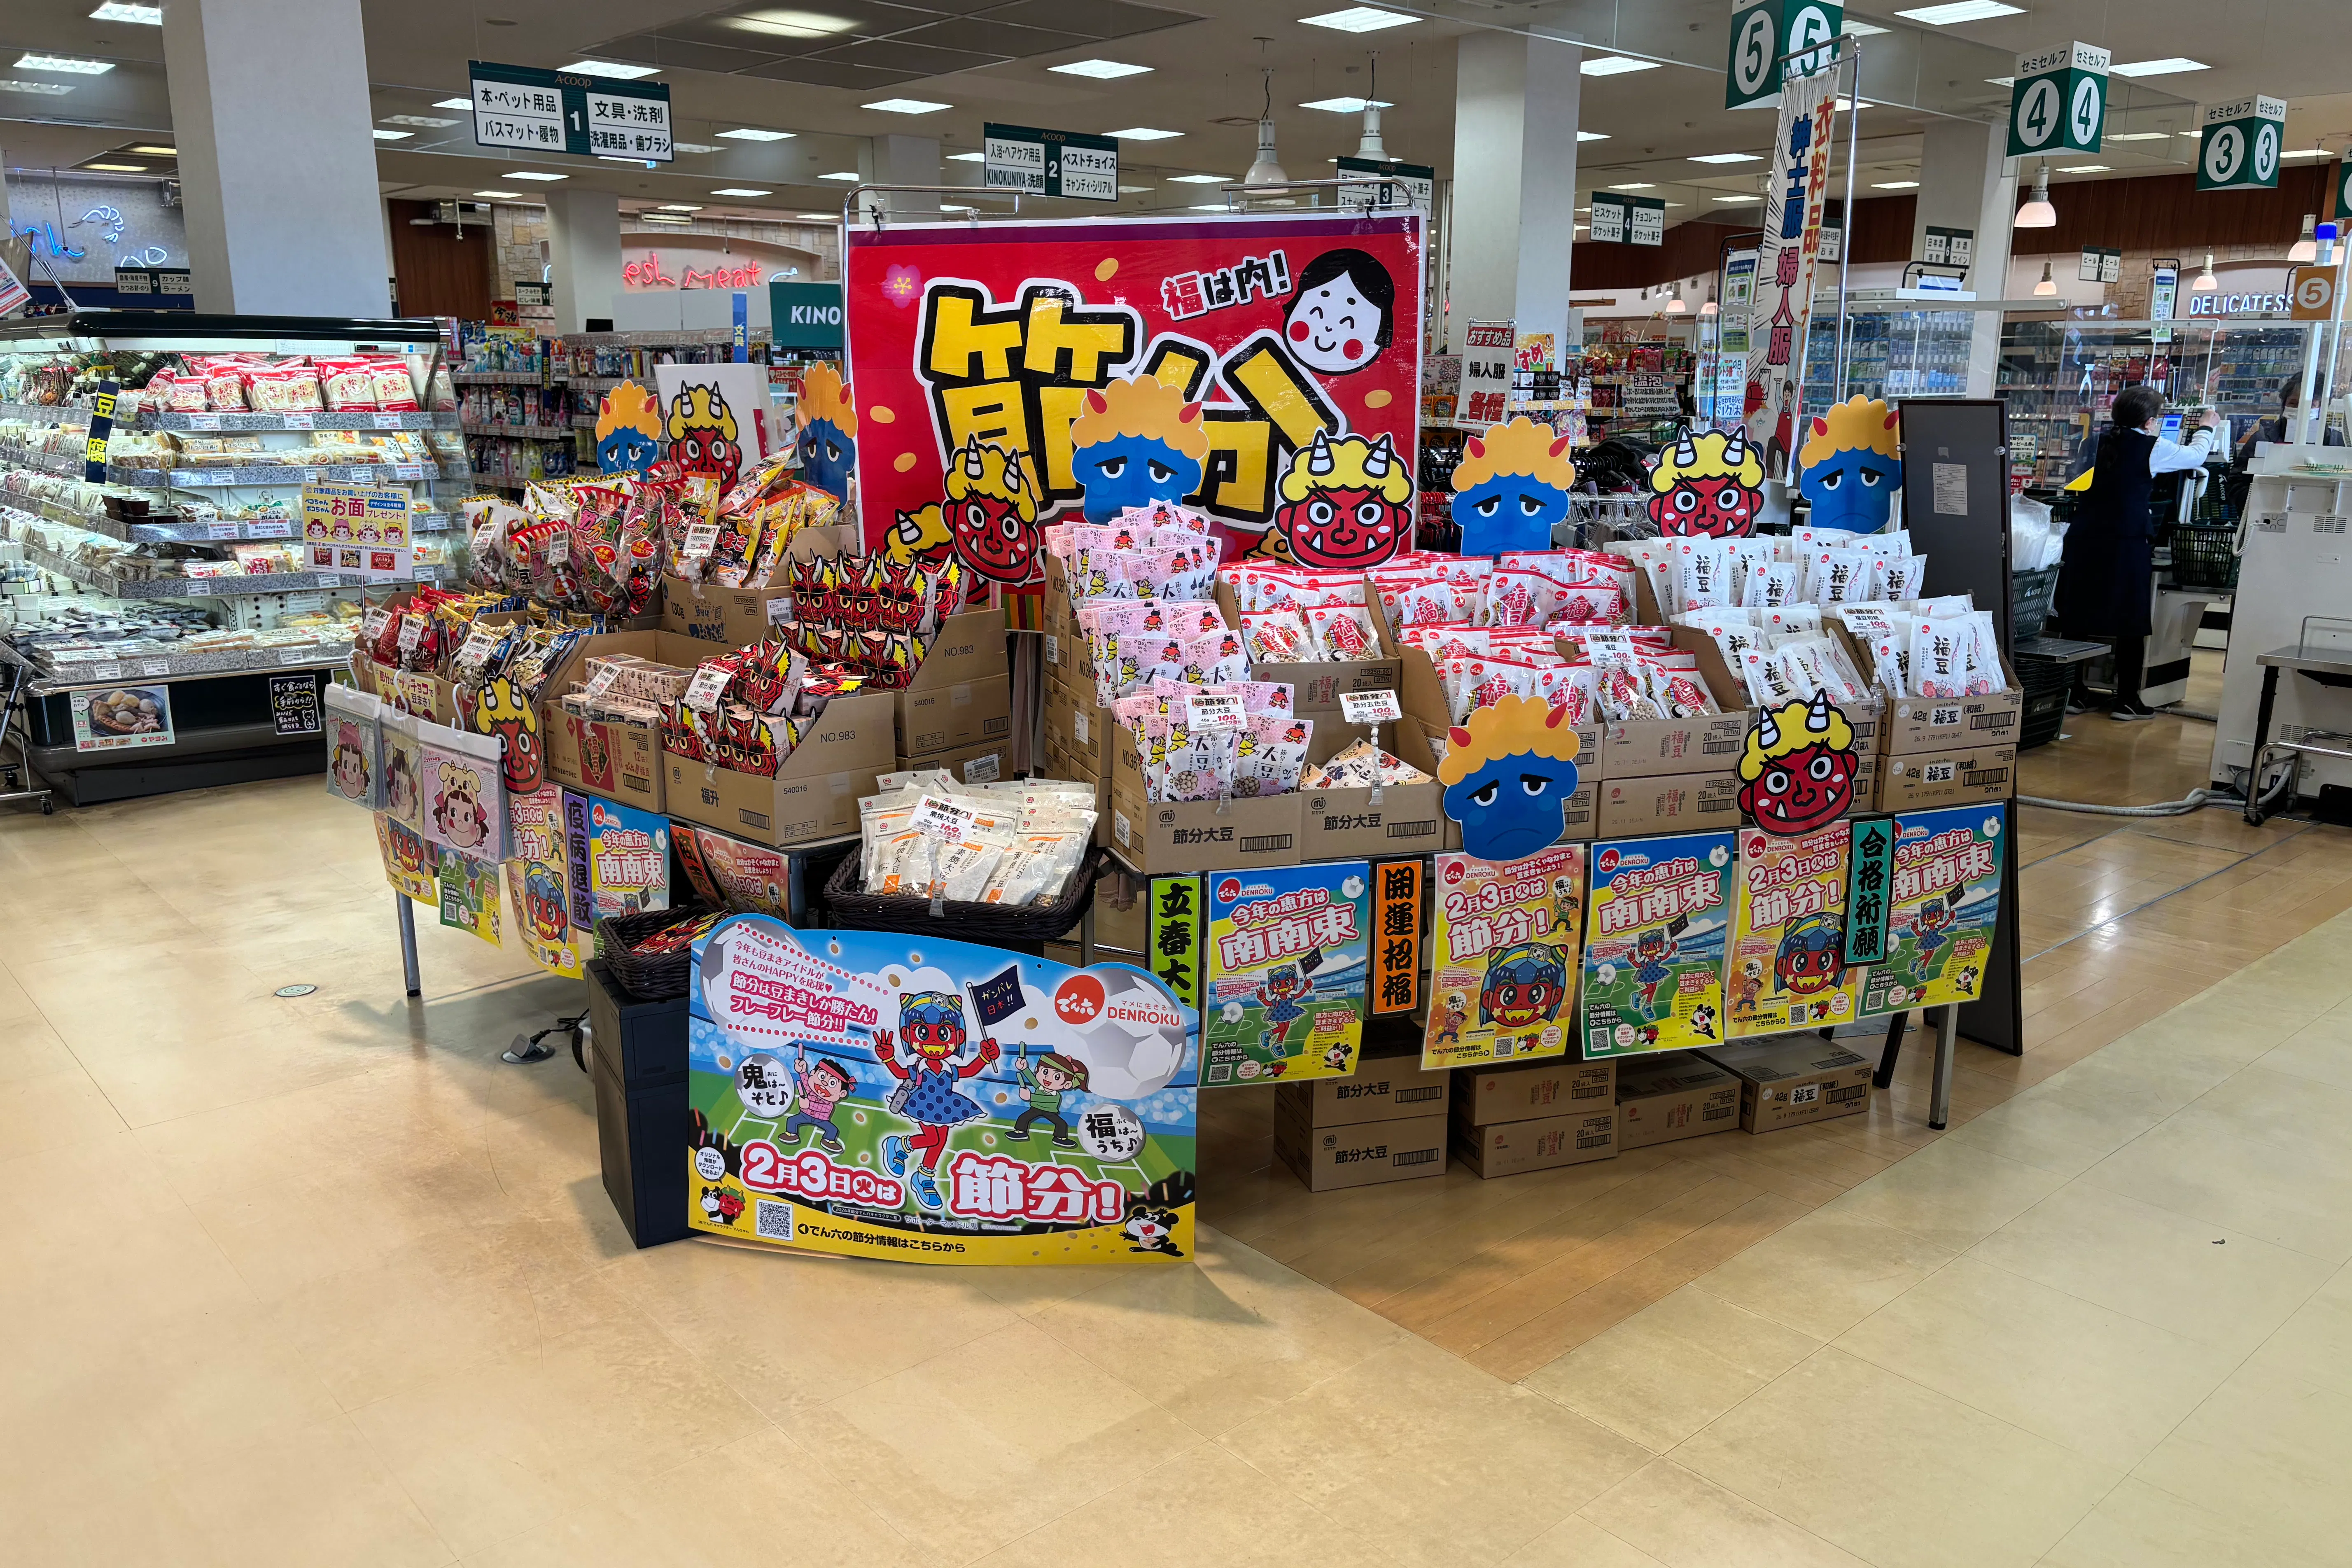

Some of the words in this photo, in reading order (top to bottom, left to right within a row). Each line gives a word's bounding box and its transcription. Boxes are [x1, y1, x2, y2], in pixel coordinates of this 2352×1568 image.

[1745, 20, 1764, 82] 5
[1801, 18, 1820, 77] 5
[2021, 51, 2066, 72] セミセルフ
[2077, 49, 2106, 68] セミセルフ
[481, 88, 556, 113] 本・ペット用品
[2209, 102, 2251, 120] セミセルフ
[2259, 101, 2283, 116] セミセルフ
[570, 111, 580, 131] 1
[595, 100, 663, 124] 文具・洗剤
[2027, 88, 2046, 137] 4
[2071, 87, 2091, 136] 4
[485, 119, 559, 144] バスマット・履物
[590, 130, 670, 154] 洗濯用品・歯ブラシ
[991, 143, 1041, 162] 入浴・ヘアケア用品
[1063, 154, 1115, 170] ベストチョイス
[2215, 133, 2232, 174] 3
[2260, 133, 2270, 173] 3
[1049, 161, 1058, 177] 2
[1066, 177, 1112, 194] キャンディ・シリアル
[1383, 188, 1389, 202] 3
[1595, 207, 1621, 219] ビスケット
[1635, 211, 1661, 223] チョコレート
[1593, 226, 1620, 238] ポケット菓子
[1625, 218, 1630, 230] 4
[1634, 229, 1660, 242] ポケット菓子
[1953, 256, 1967, 264] ワイン
[2084, 256, 2096, 264] ビール
[684, 261, 762, 289] meat
[1162, 249, 1293, 319] 福は内!
[2305, 283, 2322, 304] 5
[791, 306, 841, 325] KINO
[1467, 330, 1513, 347] おすすめ品
[1469, 361, 1505, 380] 婦人服
[1468, 391, 1506, 421] 各種
[86, 392, 117, 464] 豆腐
[313, 488, 404, 499] 対象商品をお買い上げのお客様に
[331, 497, 365, 518] お面
[366, 509, 406, 520] プレゼント!
[1695, 554, 1712, 593] 福豆
[1828, 563, 1849, 602] 福豆
[671, 601, 685, 619] 130g
[1332, 616, 1362, 656] 福豆
[945, 645, 974, 658] NO.983
[1932, 635, 1951, 676] 福豆
[1764, 661, 1791, 697] 福豆
[411, 693, 431, 707] 豆まき!
[1318, 676, 1332, 704] 福豆
[914, 698, 935, 707] 540016
[1912, 710, 1927, 722] 42g
[1932, 708, 1959, 725] 福豆
[1963, 703, 1985, 715] (和紙)
[821, 730, 856, 743] NO.983
[1671, 730, 1684, 758] 福豆
[1260, 746, 1277, 778] 大豆
[1906, 767, 1920, 779] 42g
[1926, 766, 1952, 782] 福豆
[1955, 760, 1977, 771] (和紙)
[701, 787, 719, 807] 福升
[784, 785, 807, 795] 540016
[1323, 813, 1382, 831] 節分大豆
[601, 830, 650, 849] 今年の恵方は
[1172, 826, 1234, 845] 節分大豆
[1902, 830, 1928, 838] DENROKU
[1767, 844, 1794, 852] DENROKU
[1896, 830, 1971, 864] 今年の恵方は
[568, 800, 591, 925] 疫病退散
[597, 852, 666, 888] 南南東
[1504, 852, 1573, 875] 節分はかぞくやなかまと
[1516, 862, 1563, 880] 豆まきをしよう!
[1892, 845, 1994, 901] 南南東
[1465, 870, 1496, 879] DENROKU
[1612, 859, 1696, 892] 今年の恵方は
[1241, 887, 1273, 896] DENROKU
[1600, 872, 1720, 932] 南南東
[1852, 826, 1887, 957] 合格祈願
[1234, 890, 1327, 926] 今年の恵方は
[1752, 879, 1841, 929] 節分!
[1221, 905, 1357, 967] 南南東
[1381, 865, 1416, 1008] 開運招福
[1450, 907, 1549, 958] 節分!
[734, 940, 825, 980] 今年も豆まきアイドルが
[733, 972, 877, 1024] 節分は豆まきしか勝たん!
[981, 982, 1013, 1000] ガンバレ
[730, 996, 845, 1030] フレーフレー節分!!
[987, 994, 1014, 1015] 日本!!
[1056, 993, 1096, 1016] でん六
[1121, 1000, 1168, 1011] マメに生きる
[1314, 1009, 1356, 1019] 恵方に向かって
[1107, 1008, 1181, 1027] DENROKU
[1314, 1024, 1344, 1033] ご利益が!!
[1212, 1048, 1242, 1057] 節分情報は
[1432, 1045, 1482, 1055] でん六の節分情報は
[1336, 1080, 1391, 1099] 節分大豆
[1774, 1091, 1788, 1102] 42g
[1792, 1088, 1815, 1103] 福豆
[1819, 1080, 1839, 1091] (和紙)
[700, 1151, 721, 1160] オリジナル
[698, 1162, 723, 1171] ダウンロード
[955, 1157, 1118, 1216] 節分!
[809, 1226, 966, 1253] でん六の節分情報はこちらから
